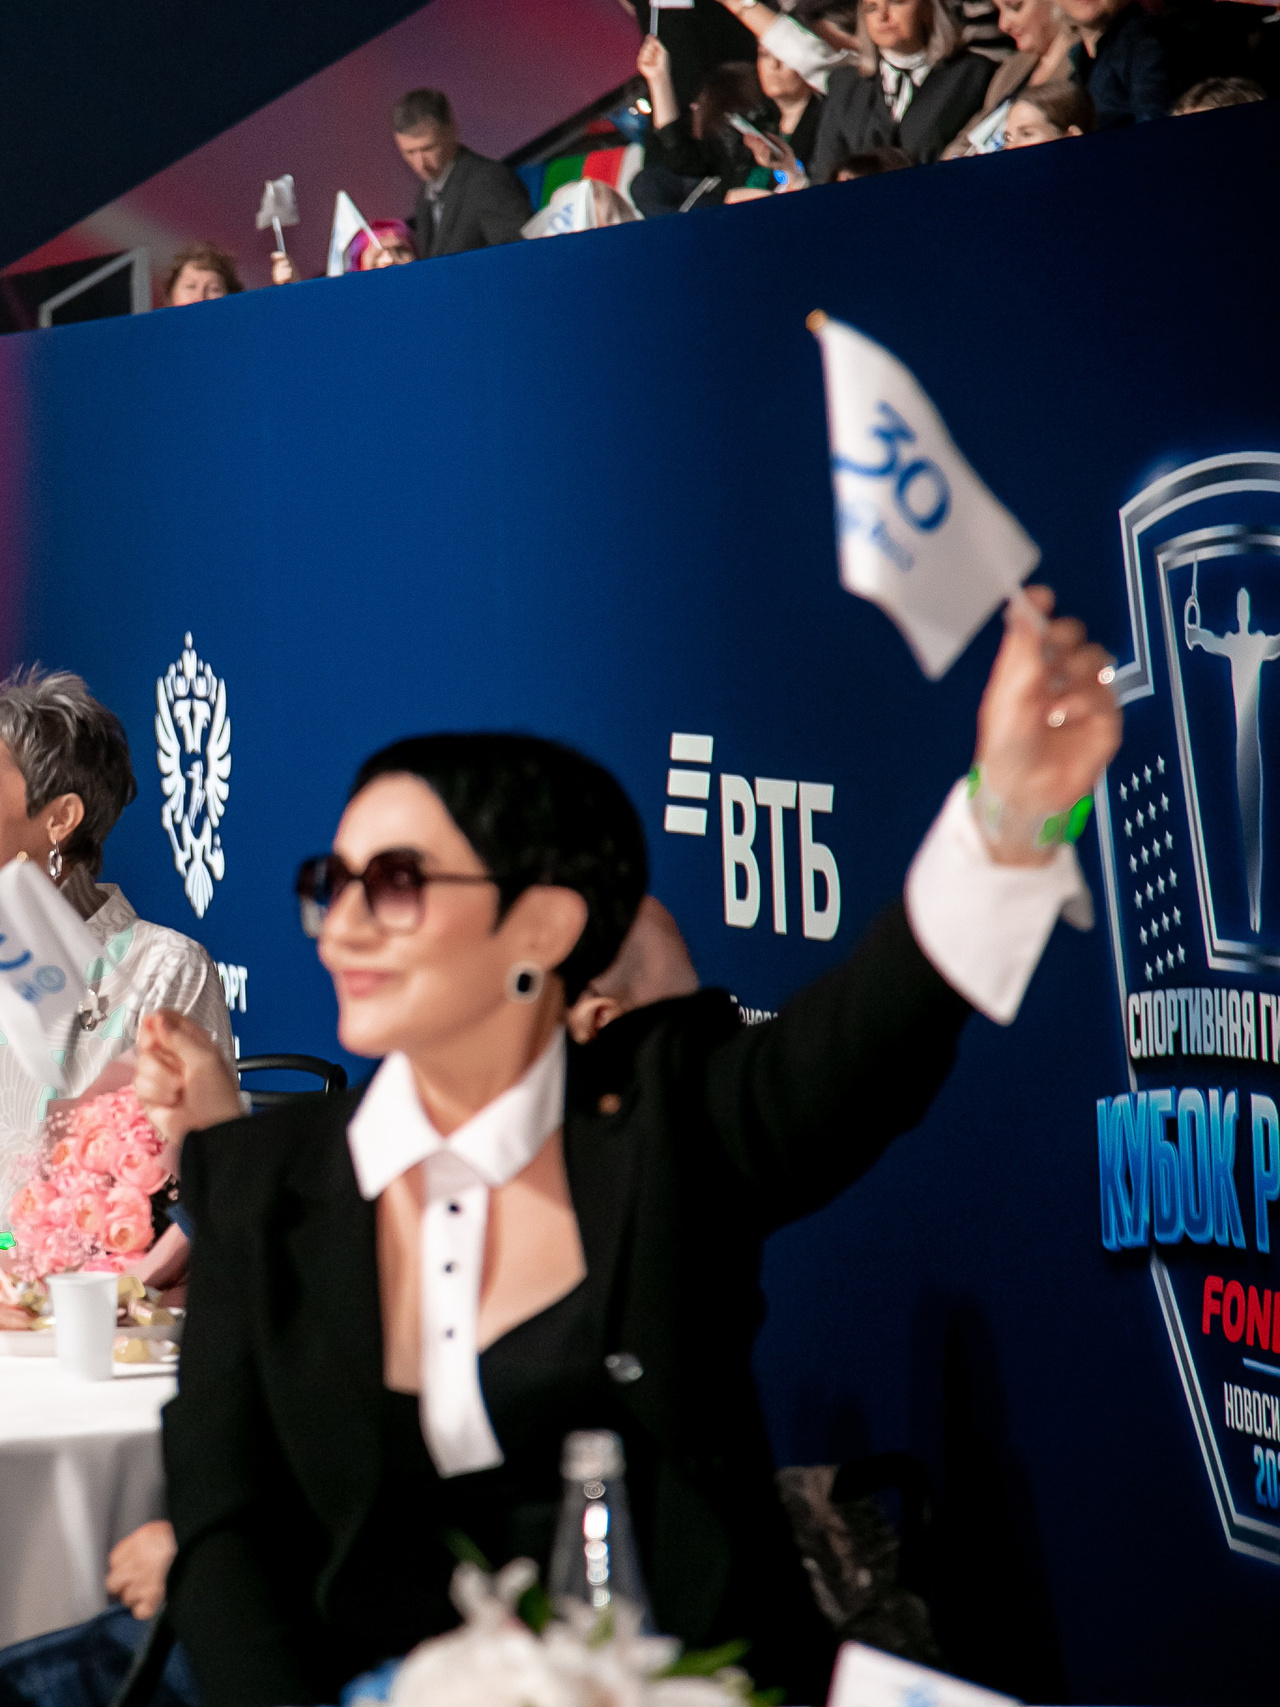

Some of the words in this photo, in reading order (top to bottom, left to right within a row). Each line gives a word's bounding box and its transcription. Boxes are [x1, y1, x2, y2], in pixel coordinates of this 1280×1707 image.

[833, 400, 952, 534] 30
[720, 773, 842, 942] ВТБ
[214, 961, 248, 1013] ОРТ
[1128, 987, 1258, 1060] СПОРТИВНАЯ
[1096, 1086, 1247, 1253] КУБОК
[1253, 1444, 1280, 1510] 20
